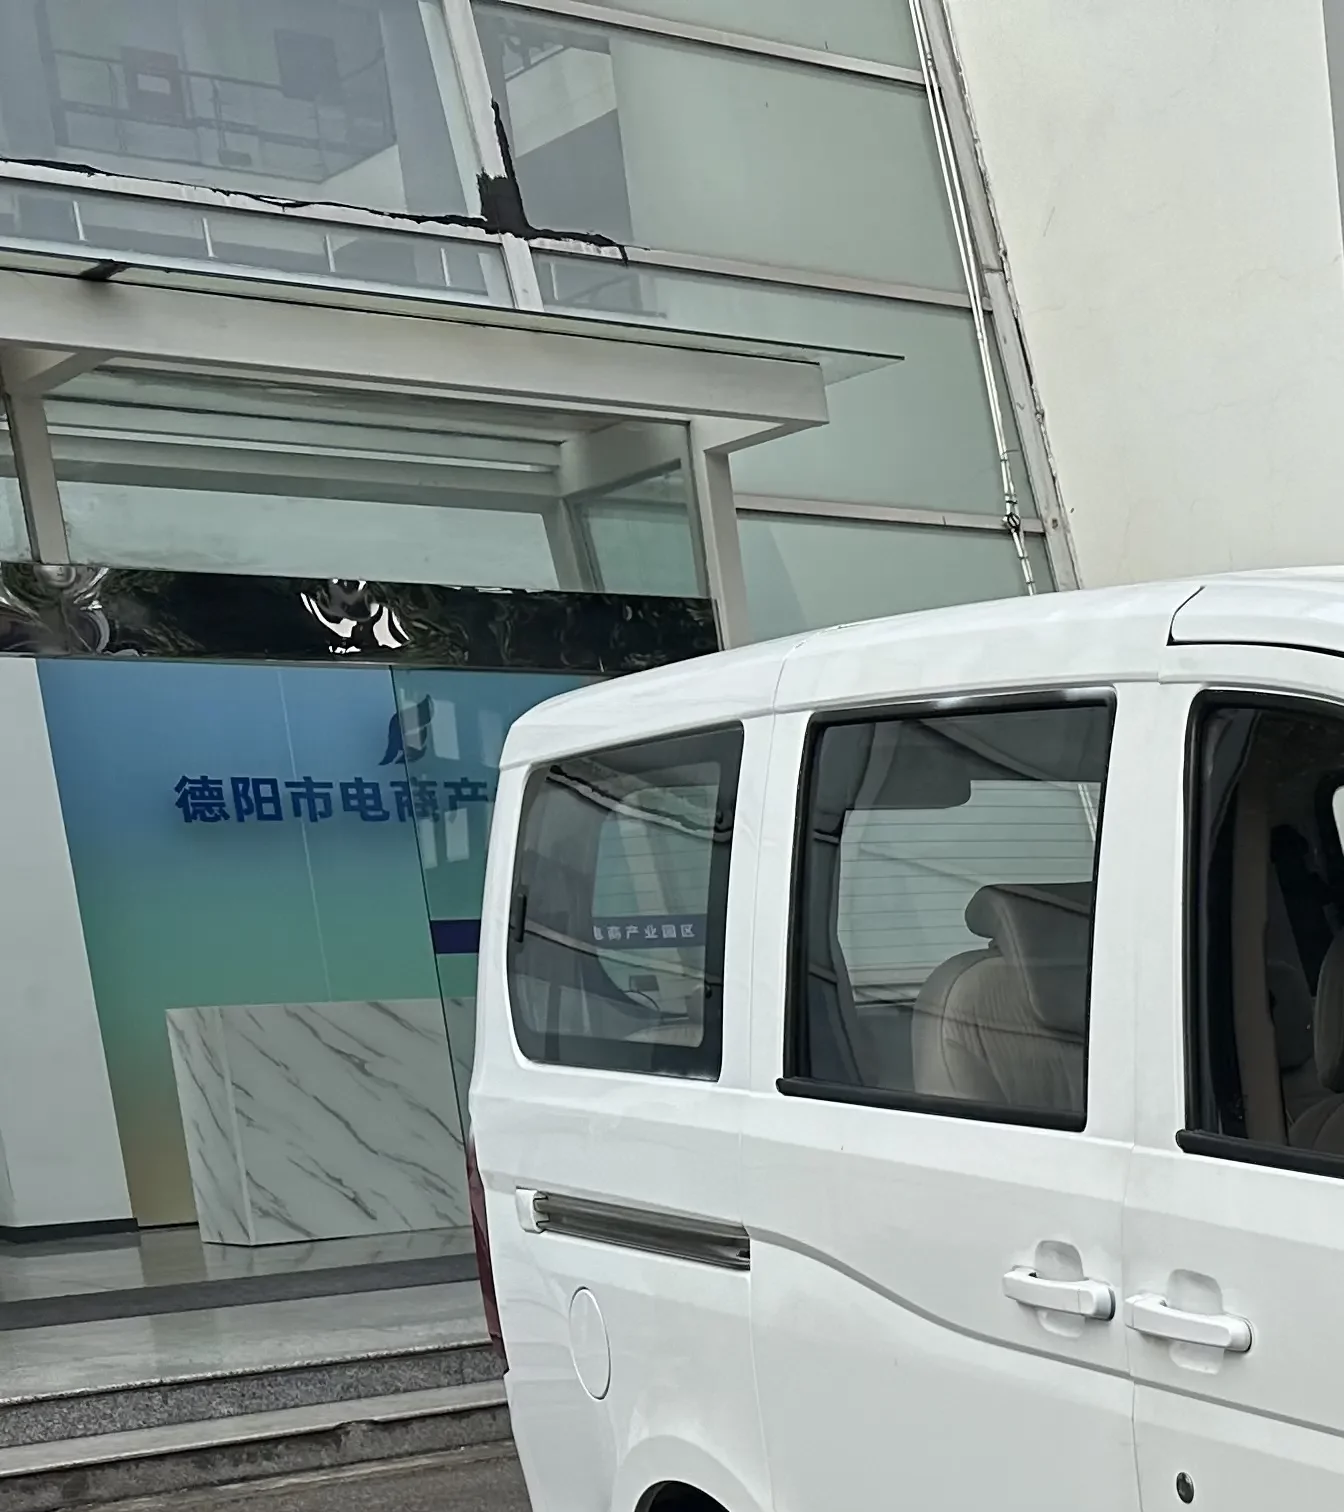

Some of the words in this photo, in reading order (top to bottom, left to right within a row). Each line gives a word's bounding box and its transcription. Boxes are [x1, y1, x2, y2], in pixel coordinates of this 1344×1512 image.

[174, 775, 490, 823] 德阳市电商产
